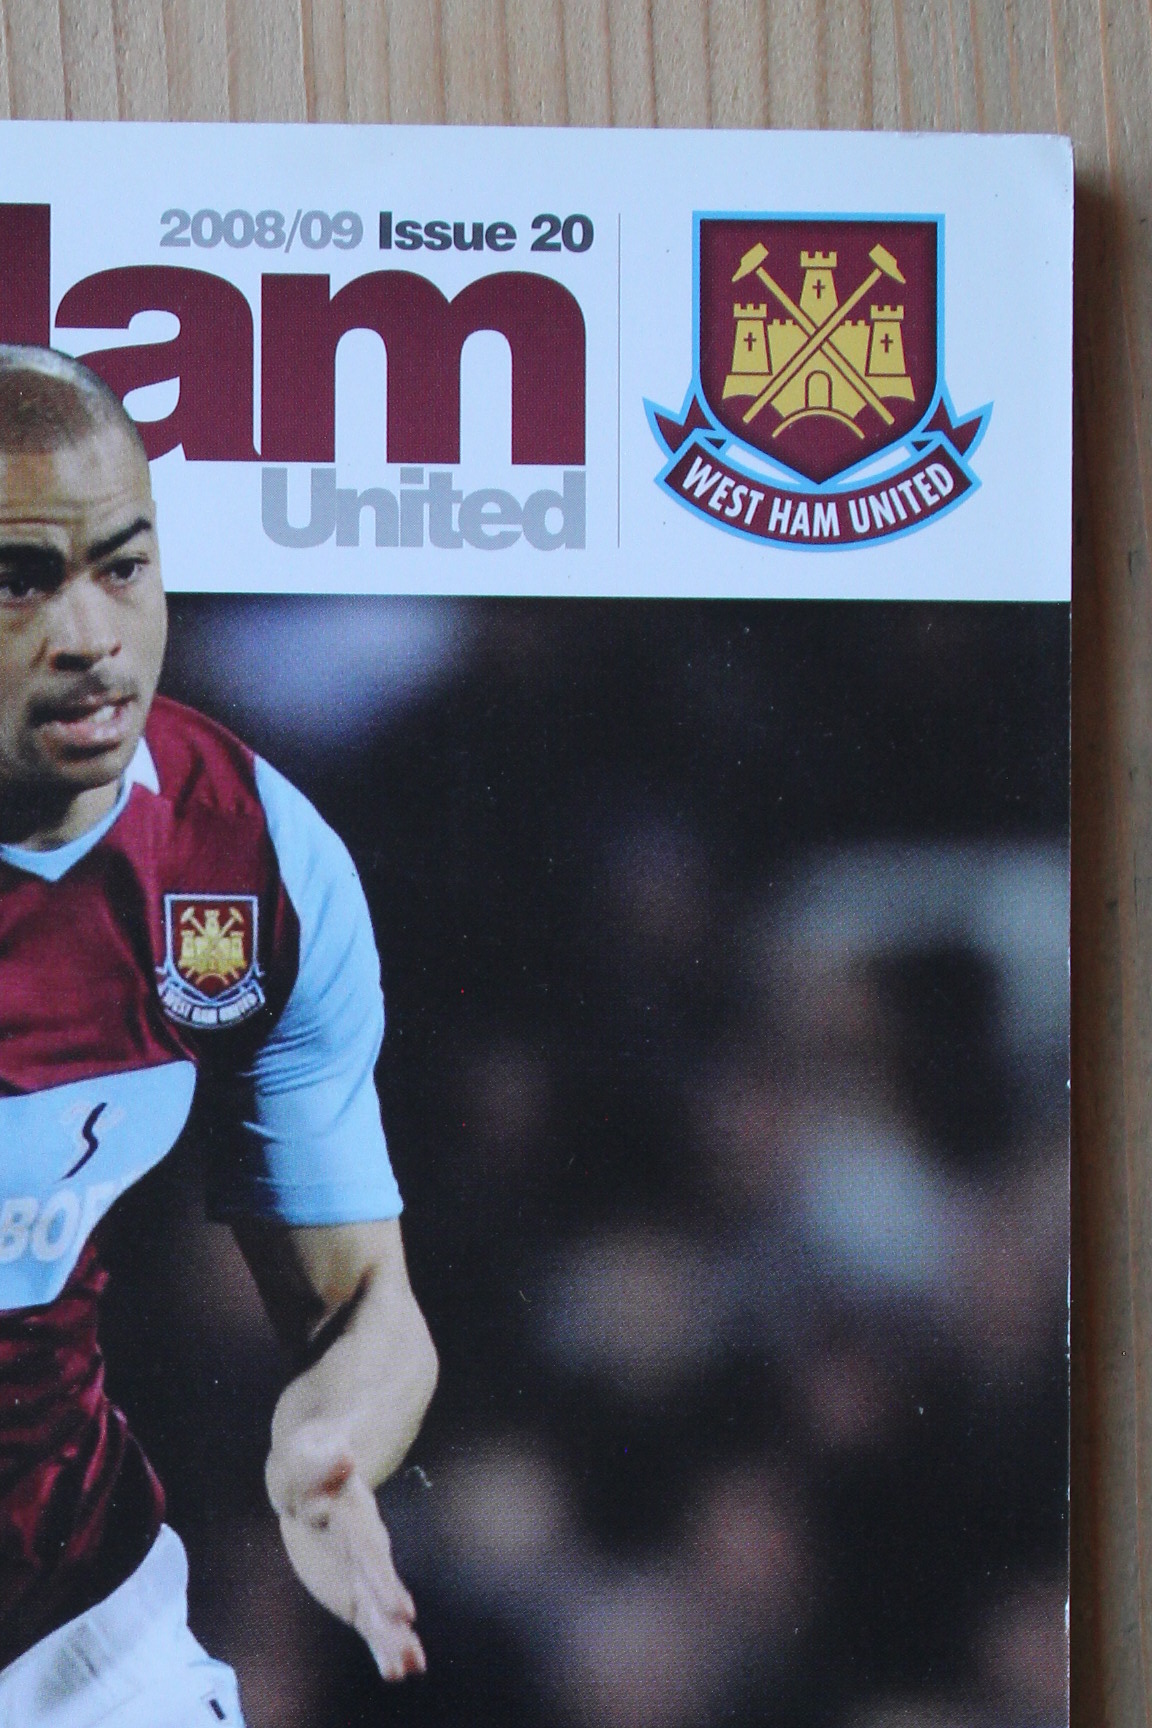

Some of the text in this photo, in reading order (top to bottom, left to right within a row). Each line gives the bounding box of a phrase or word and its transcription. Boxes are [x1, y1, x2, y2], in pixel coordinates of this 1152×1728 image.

[160, 208, 594, 254] 2008/09 Issue 20
[261, 466, 587, 550] United
[681, 456, 955, 538] WEST HAM UNITED
